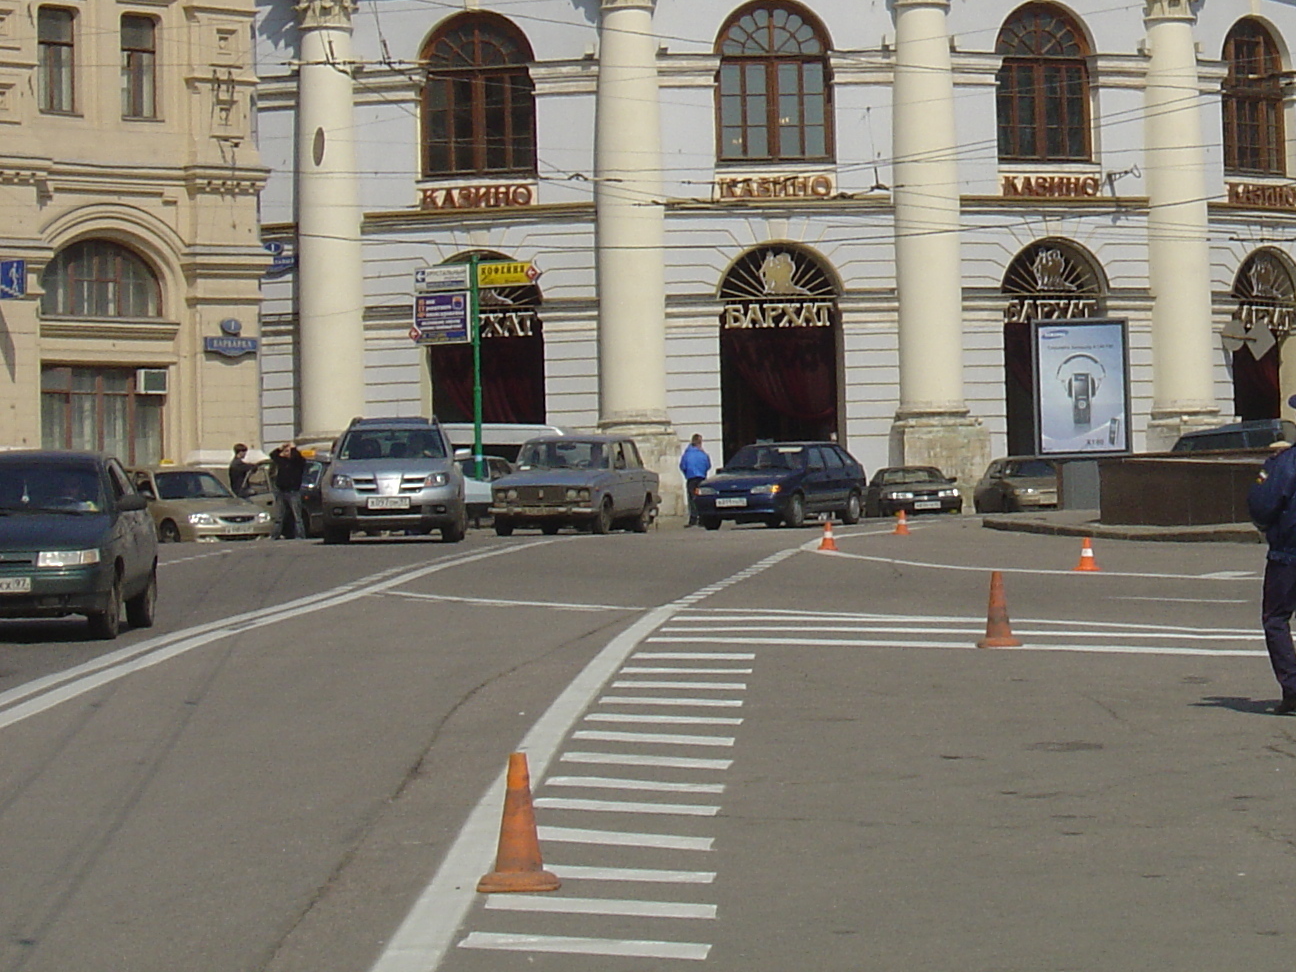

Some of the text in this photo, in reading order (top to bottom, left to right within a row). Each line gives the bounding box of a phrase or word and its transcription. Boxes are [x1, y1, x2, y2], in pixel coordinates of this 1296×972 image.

[421, 185, 532, 210] КАЗИНО
[717, 175, 832, 199] КАЗИНО
[1003, 176, 1098, 197] КАЗИНО
[724, 302, 834, 329] БАРХАТ
